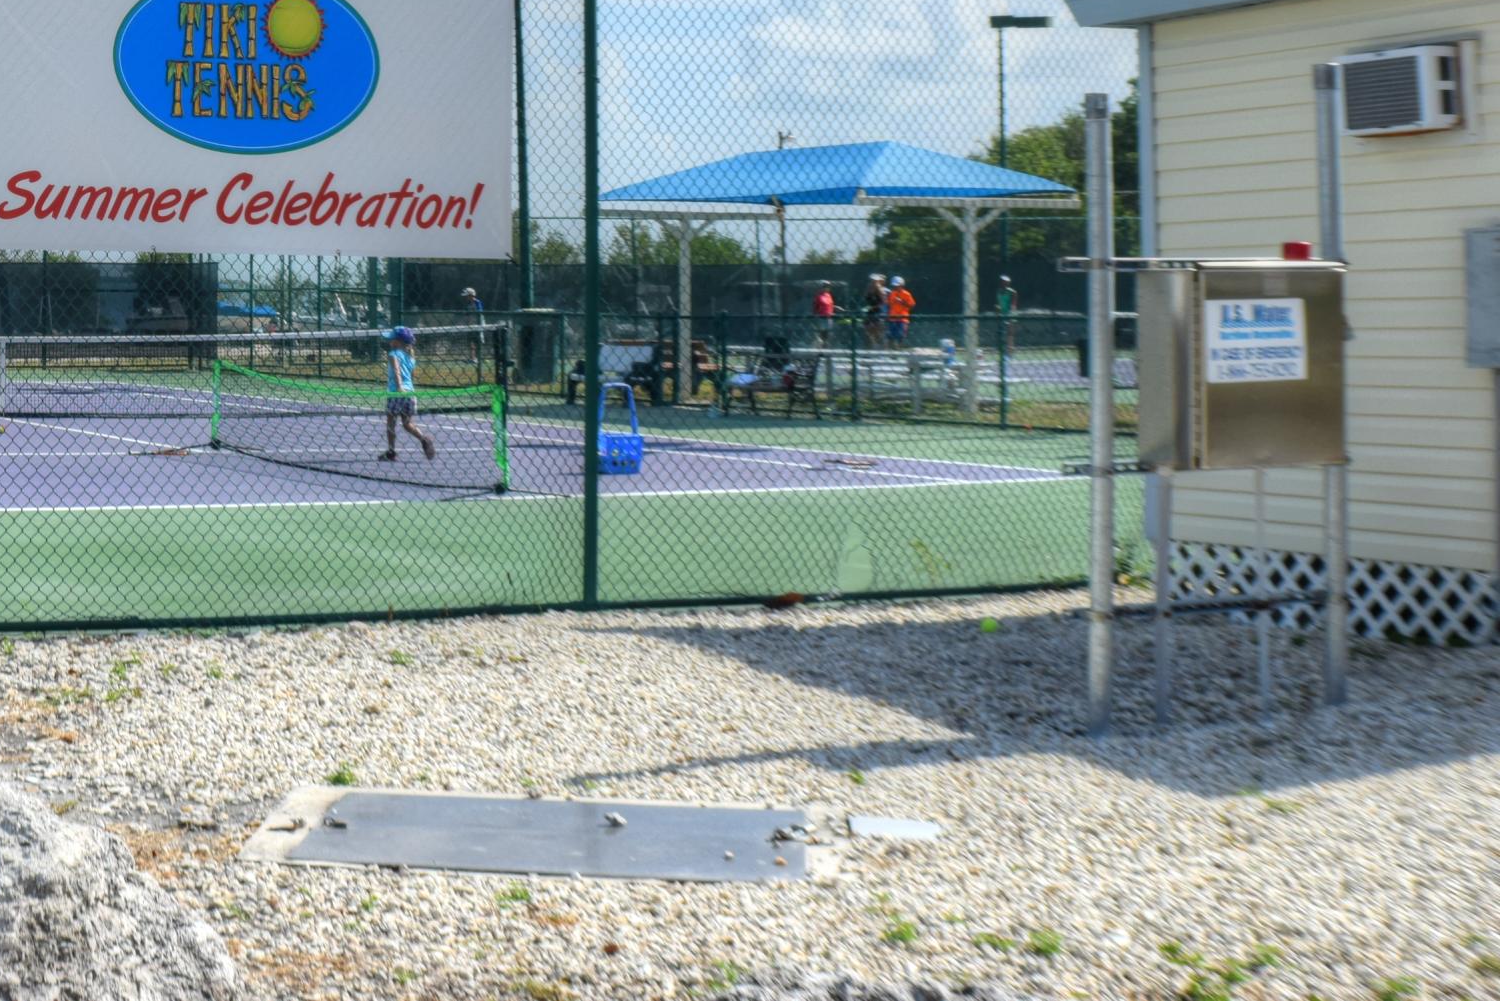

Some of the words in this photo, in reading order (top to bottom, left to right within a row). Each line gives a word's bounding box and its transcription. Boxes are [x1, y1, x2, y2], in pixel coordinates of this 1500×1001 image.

[178, 2, 258, 60] TIKI
[165, 60, 318, 122] TENNIS
[215, 171, 486, 230] Celebration!
